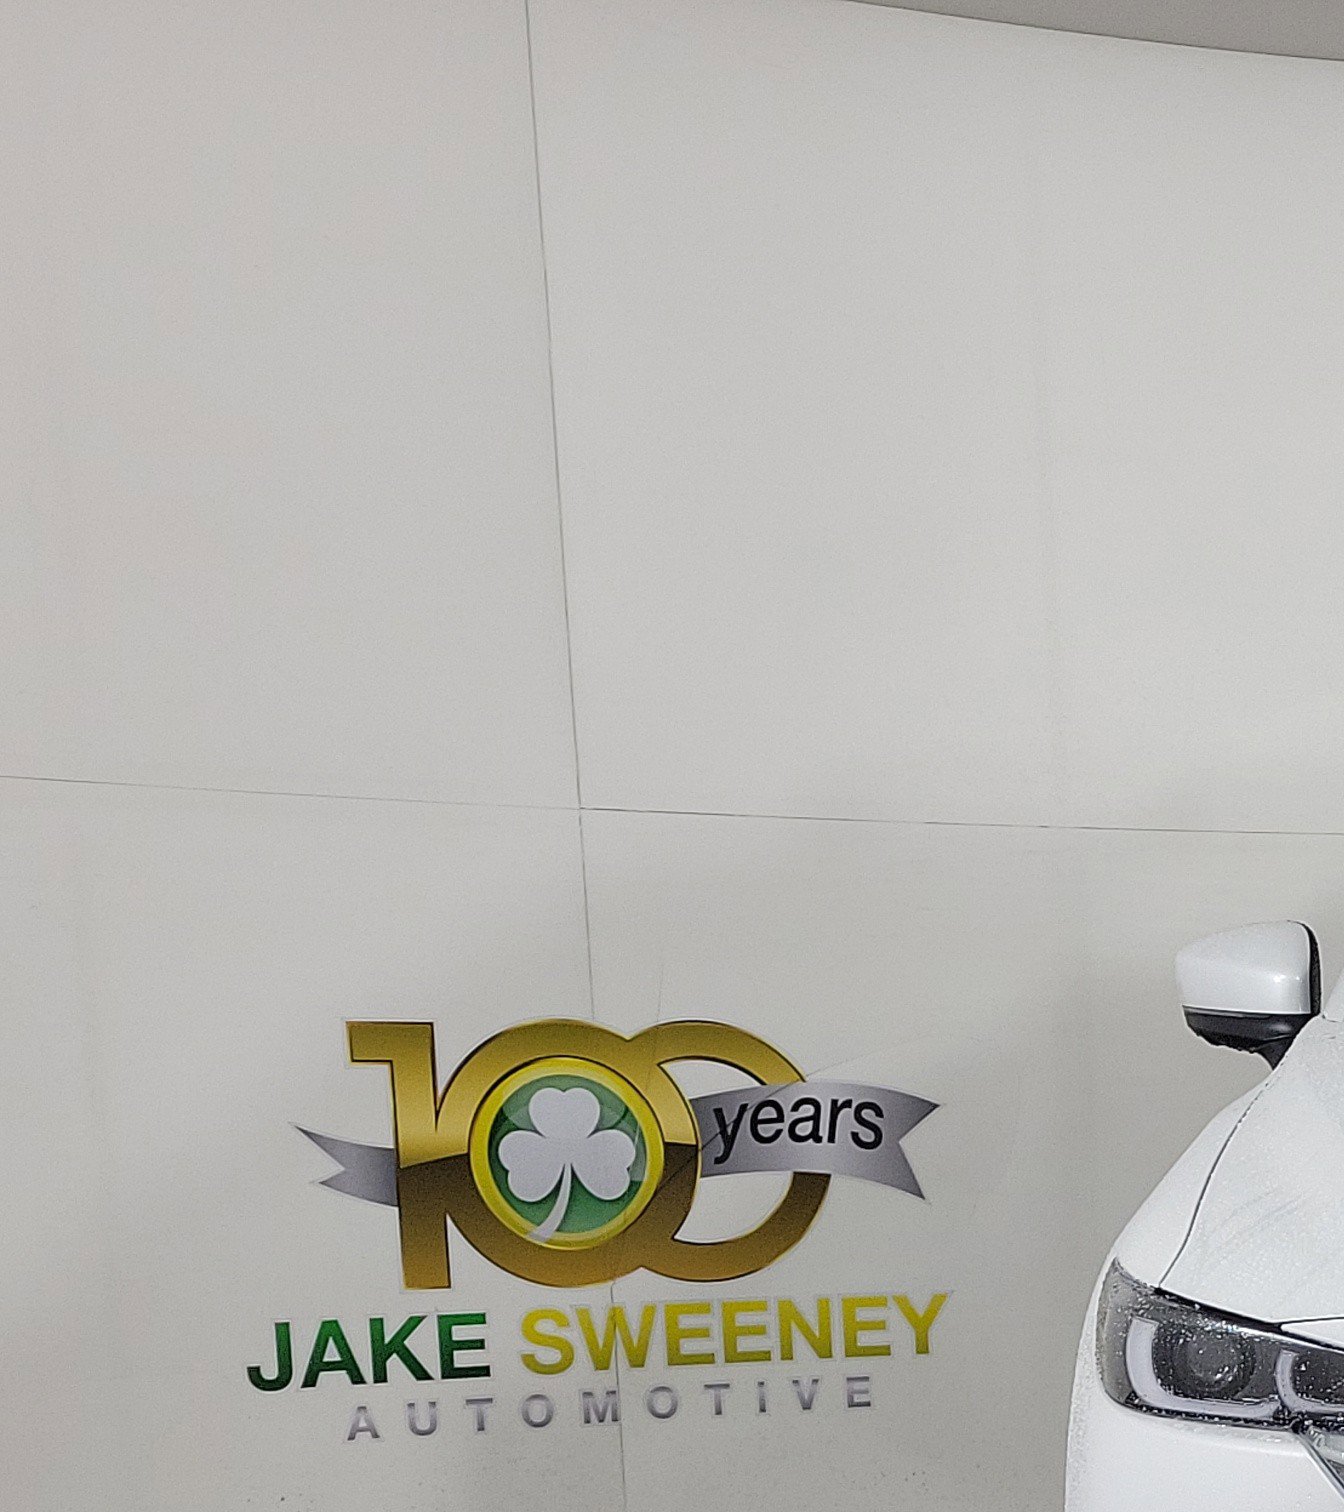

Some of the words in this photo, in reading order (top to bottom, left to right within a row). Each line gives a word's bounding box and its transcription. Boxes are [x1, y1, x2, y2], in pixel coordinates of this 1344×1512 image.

[345, 1019, 832, 1290] 100
[713, 1096, 886, 1164] years
[247, 1312, 492, 1392] JAKE
[520, 1292, 949, 1376] SWEENEY
[347, 1376, 873, 1442] AUTOMOTIVE
